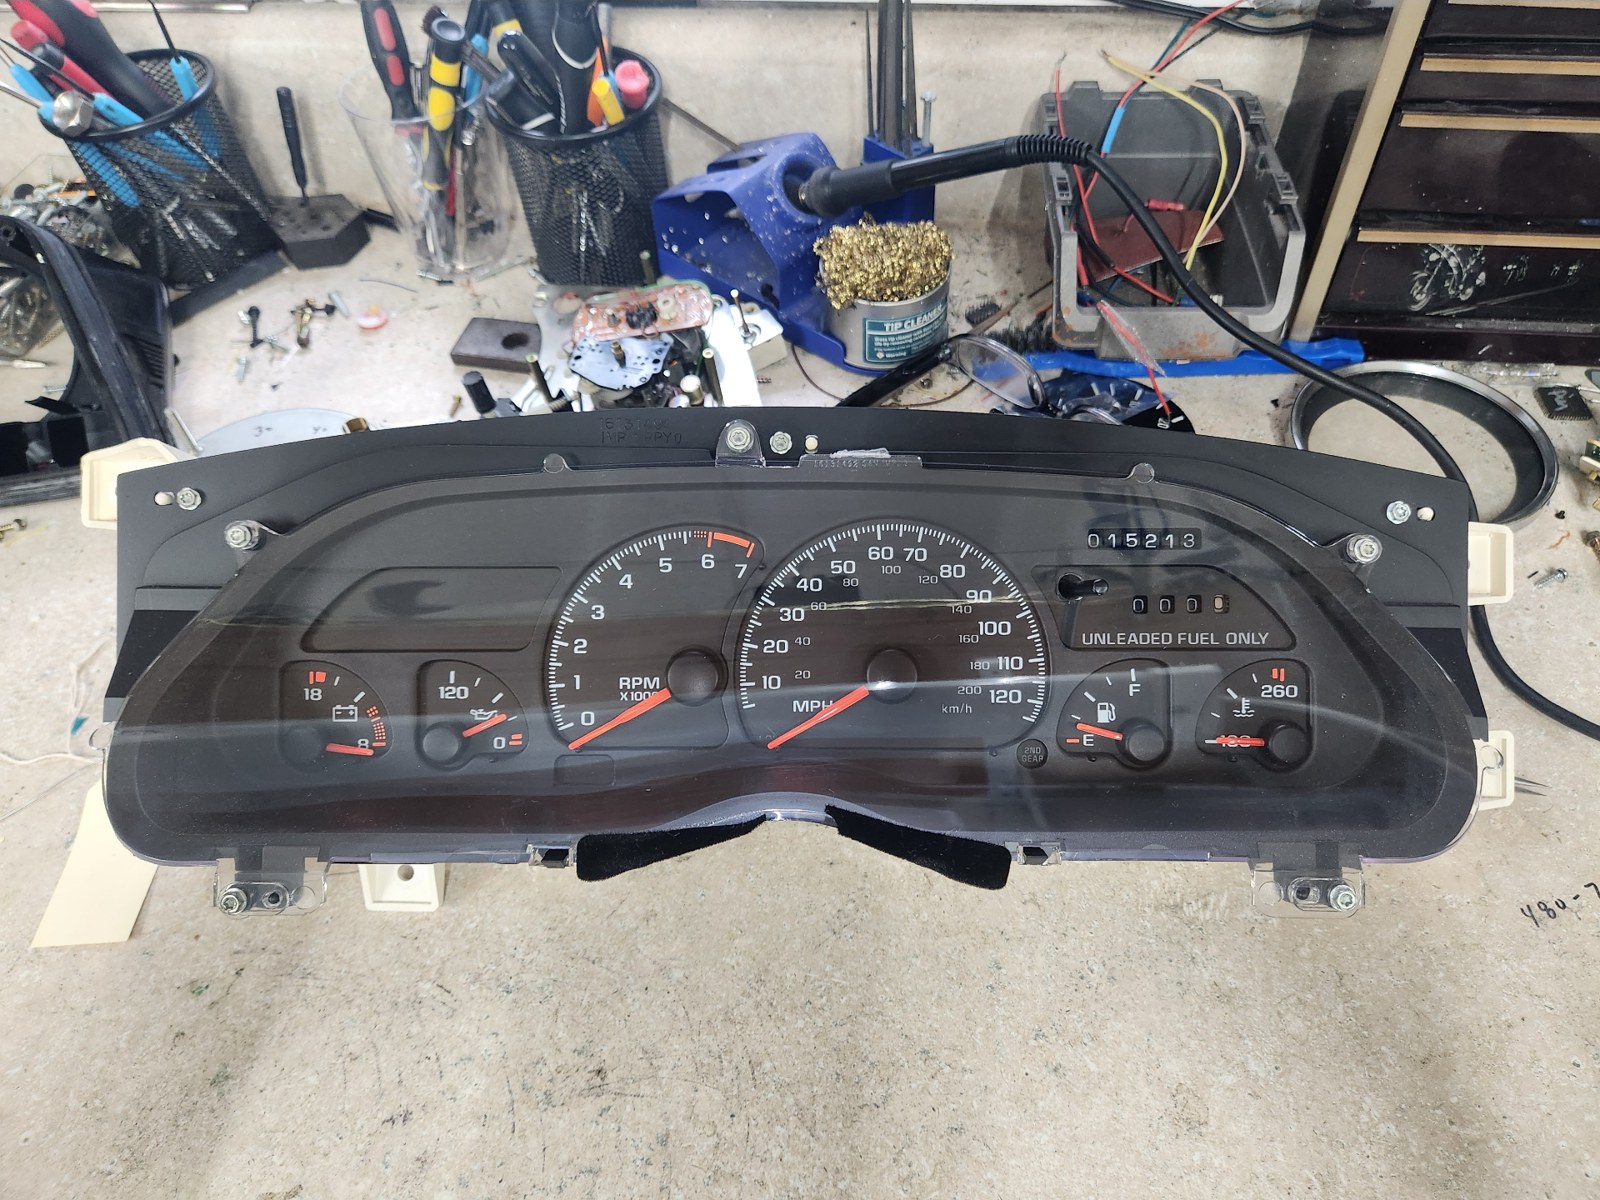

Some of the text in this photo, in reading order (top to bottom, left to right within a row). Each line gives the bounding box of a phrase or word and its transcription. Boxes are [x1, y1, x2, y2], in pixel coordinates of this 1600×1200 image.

[884, 322, 902, 332] TIP
[868, 546, 894, 560] 60
[903, 547, 928, 562] 70
[659, 557, 673, 573] 5
[701, 554, 715, 569] 6
[830, 560, 856, 574] 50
[734, 564, 748, 579] 7
[881, 565, 902, 574] 100
[939, 564, 966, 578] 80
[619, 574, 633, 589] 4
[796, 578, 822, 592] 40
[842, 578, 859, 587] 80
[918, 575, 938, 584] 120
[966, 589, 992, 603] 90
[591, 605, 605, 620] 3
[810, 602, 827, 611] 60
[951, 605, 972, 614] 140
[779, 607, 805, 621] 30
[978, 621, 1012, 636] 100
[794, 636, 811, 646] 40
[959, 634, 979, 643] 160
[1082, 632, 1269, 645] UNLEADED FUEL ONLY
[573, 638, 588, 654] 2
[763, 639, 789, 653] 20
[970, 661, 991, 670] 180
[997, 656, 1024, 670] 110
[794, 670, 811, 679] 20
[573, 674, 581, 690] 1
[619, 676, 660, 689] RPM
[762, 675, 781, 689] 10
[303, 687, 323, 701] 18
[438, 686, 469, 700] 120
[957, 686, 982, 695] 200
[989, 689, 1022, 704] 120
[1129, 683, 1141, 697] F
[1260, 684, 1298, 698] 260
[792, 700, 833, 712] MPH
[941, 703, 973, 714] km/h
[580, 711, 595, 726] 0
[358, 738, 369, 749] 8
[493, 737, 506, 749] 0
[1082, 734, 1094, 746] E
[1024, 746, 1041, 754] 2ND
[1021, 755, 1044, 763] GEAR
